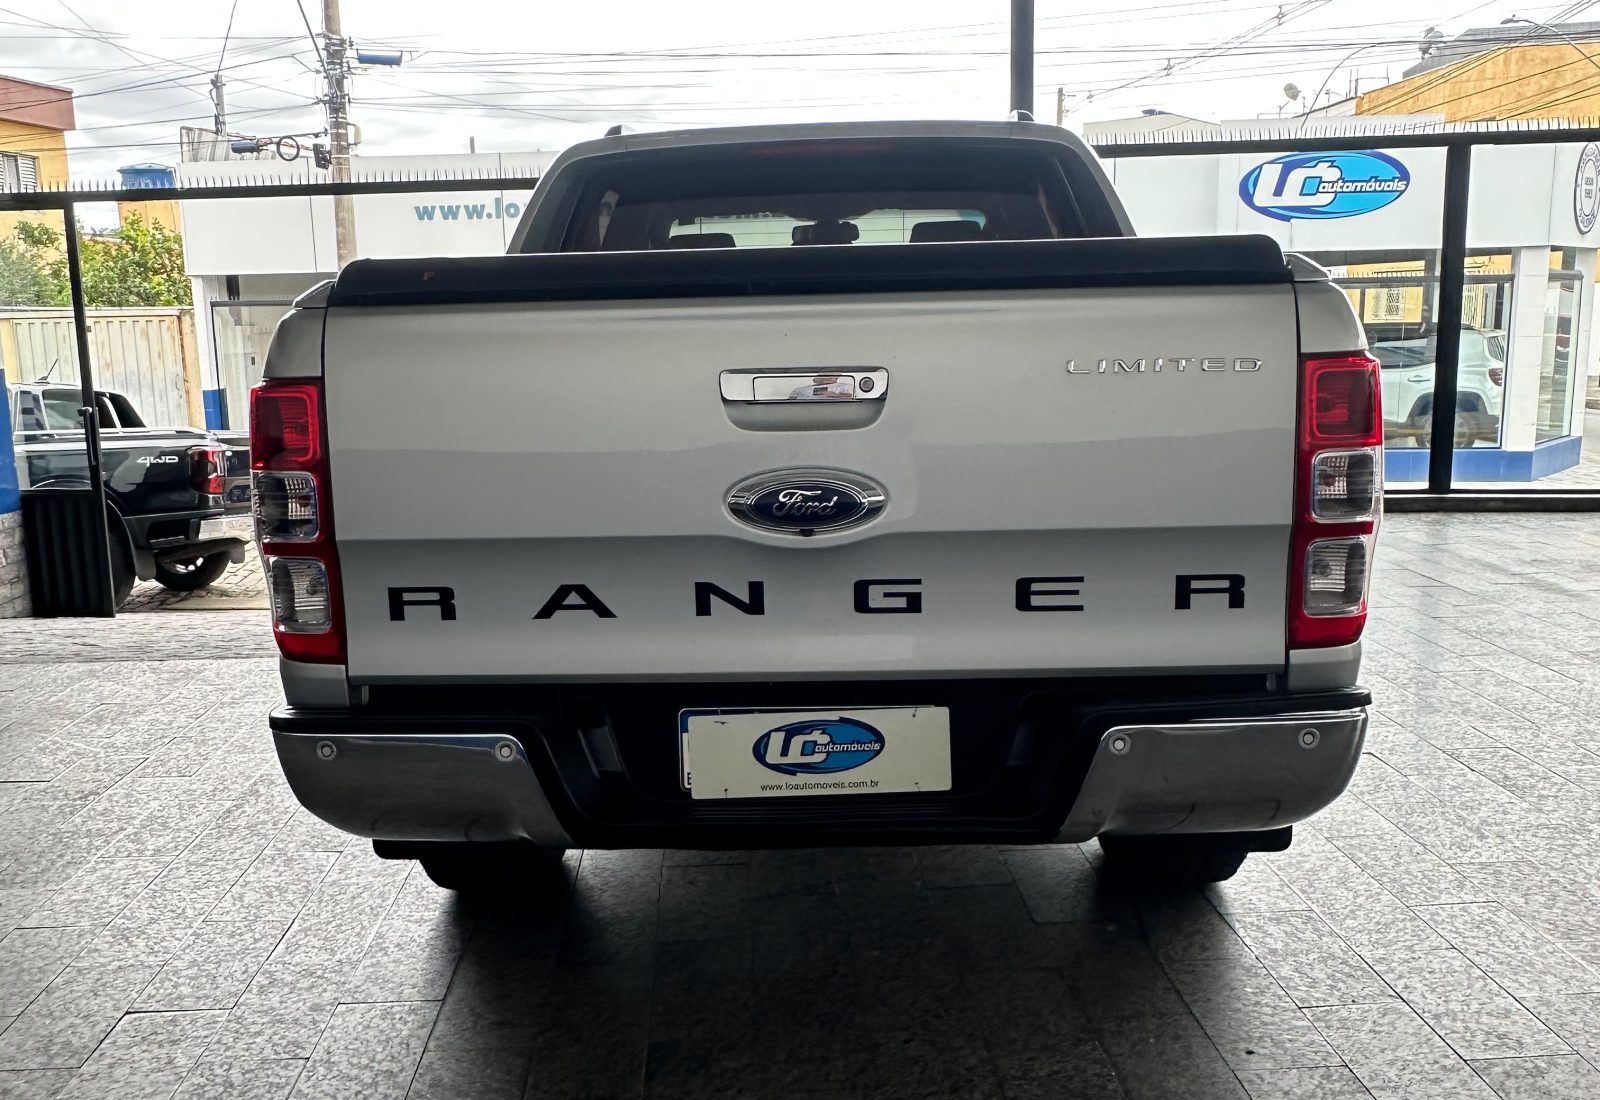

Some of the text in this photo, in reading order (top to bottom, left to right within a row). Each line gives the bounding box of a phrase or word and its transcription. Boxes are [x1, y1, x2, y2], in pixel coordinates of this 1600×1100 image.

[414, 197, 527, 221] www.lo
[1066, 357, 1263, 374] LIMITED
[136, 455, 179, 467] 4WD
[772, 489, 838, 517] Ford
[387, 574, 1245, 621] RANGER
[760, 779, 880, 792] www.loautomoveis.com.br
